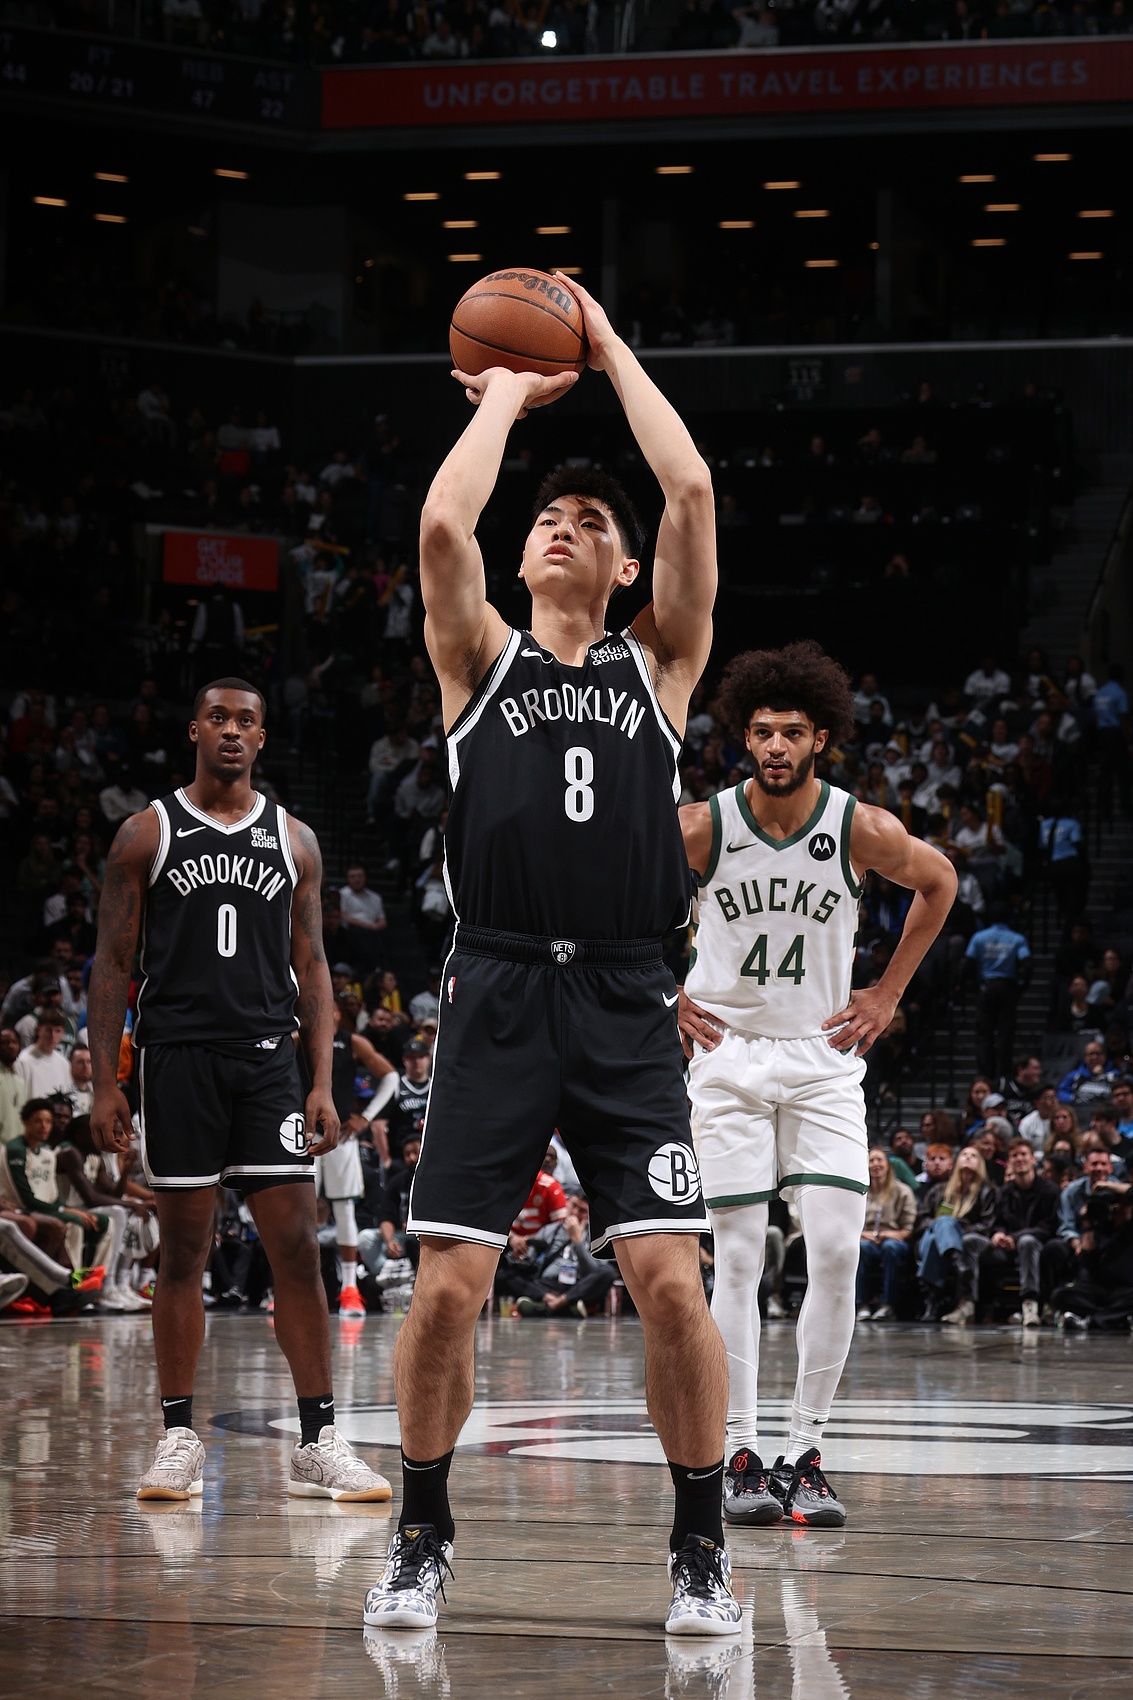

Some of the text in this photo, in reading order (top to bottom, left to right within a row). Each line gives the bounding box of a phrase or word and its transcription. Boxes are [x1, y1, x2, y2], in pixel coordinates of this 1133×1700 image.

[88, 45, 114, 67] FT
[254, 69, 294, 93] AST
[422, 58, 1089, 110] UNFORGETTABLE TRAVEL EXPERIENCES
[190, 89, 216, 109] 47
[260, 97, 285, 119] 22
[485, 271, 572, 315] Wilson
[197, 537, 228, 556] GET
[198, 553, 243, 571] YOUR
[196, 566, 245, 585] GUIDE
[499, 683, 647, 740] BROOKLYN
[564, 746, 595, 823] 8
[251, 827, 267, 835] GET
[251, 833, 276, 842] YOUR
[251, 840, 278, 850] GUIDE
[166, 853, 287, 902] BROOKLYN
[714, 878, 841, 924] BUCKS
[217, 903, 237, 958] 0
[553, 943, 573, 953] NETS
[740, 934, 805, 985] 44
[295, 1118, 306, 1150] B
[670, 1150, 690, 1197] B
